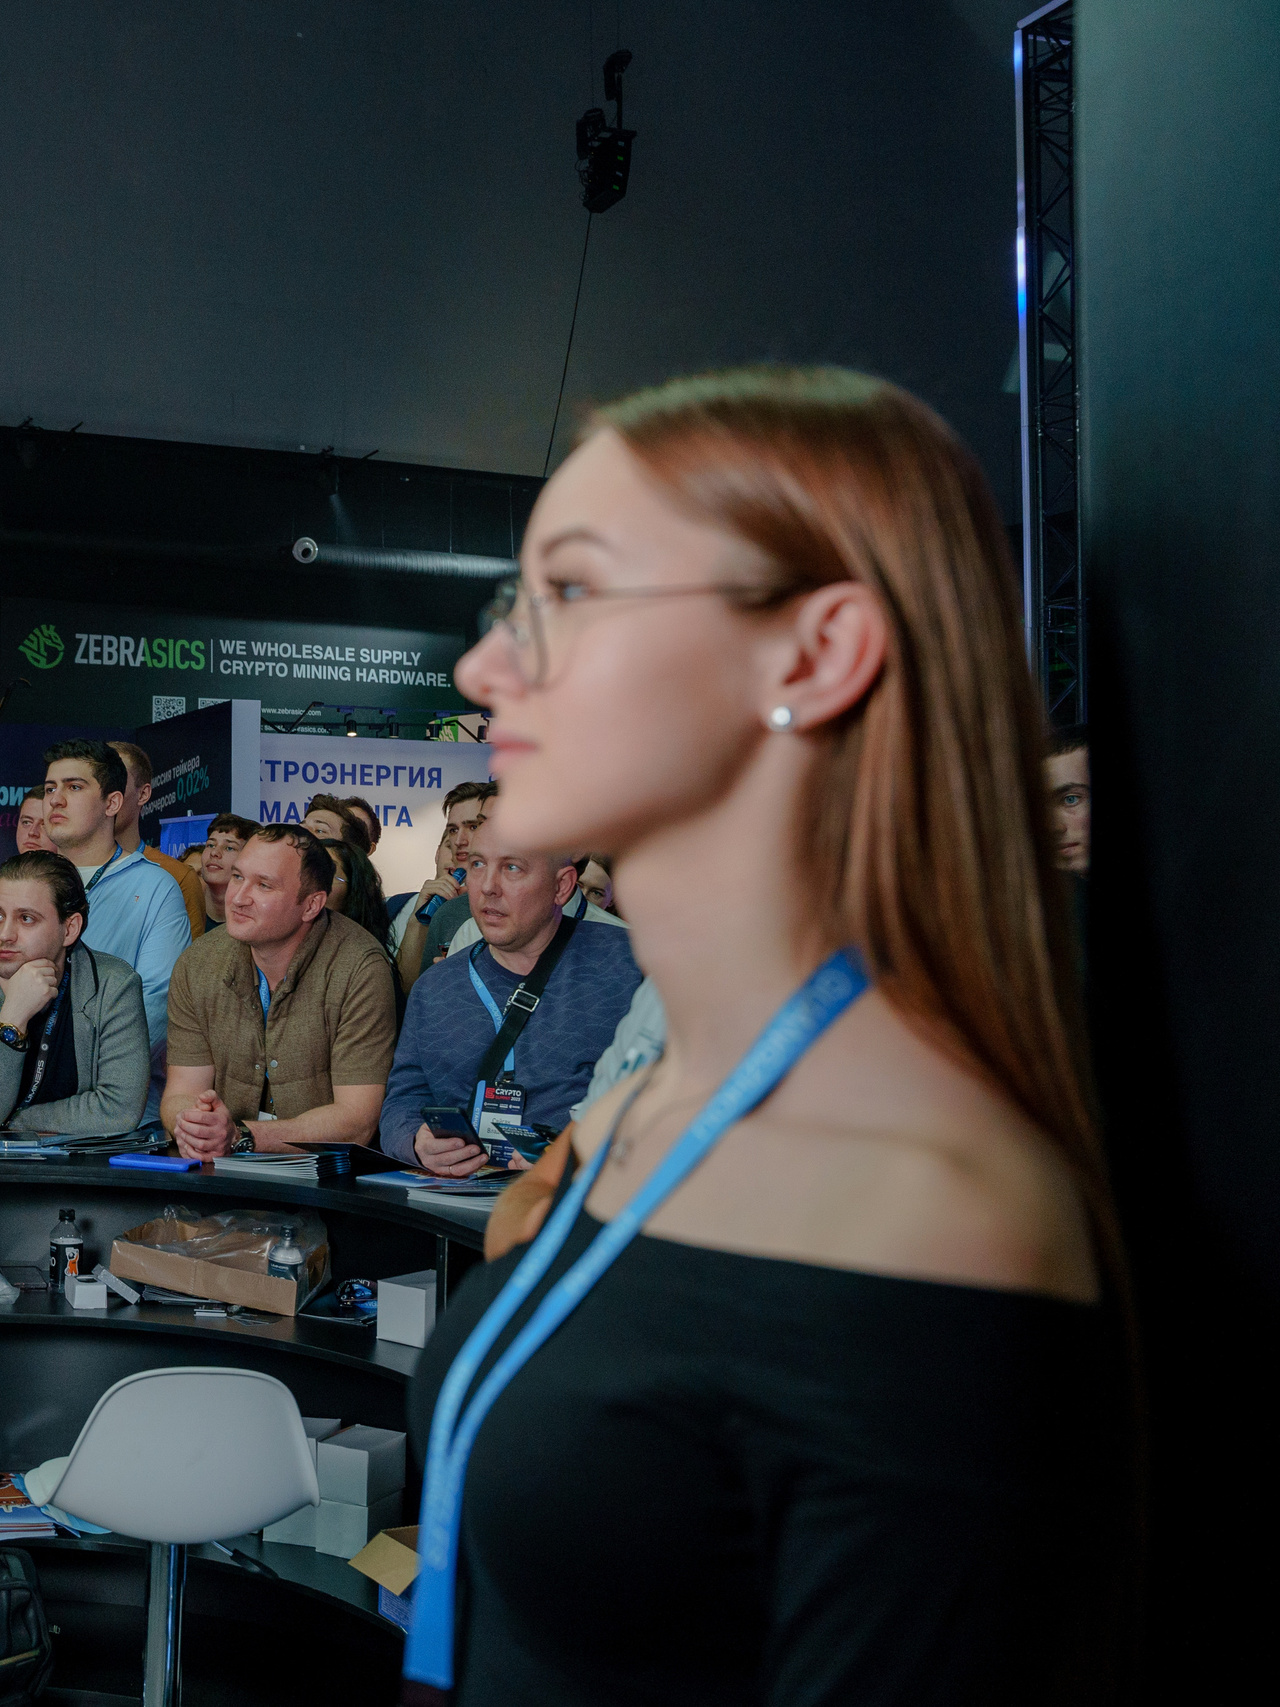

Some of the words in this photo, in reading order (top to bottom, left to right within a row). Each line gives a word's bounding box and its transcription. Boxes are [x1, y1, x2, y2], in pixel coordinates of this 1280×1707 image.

[74, 633, 206, 670] ZEBRASICS
[219, 639, 247, 656] WE
[250, 641, 356, 662] WHOLESALE
[360, 648, 422, 667] SUPPLY
[219, 659, 288, 678] CRYPTO
[293, 664, 351, 682] MINING
[355, 667, 452, 688] HARDWARE.
[261, 708, 322, 716] www.zebrasic.com
[172, 755, 200, 779] тейкера
[177, 765, 210, 803] 0,02%
[495, 1088, 522, 1097] CRYPTO
